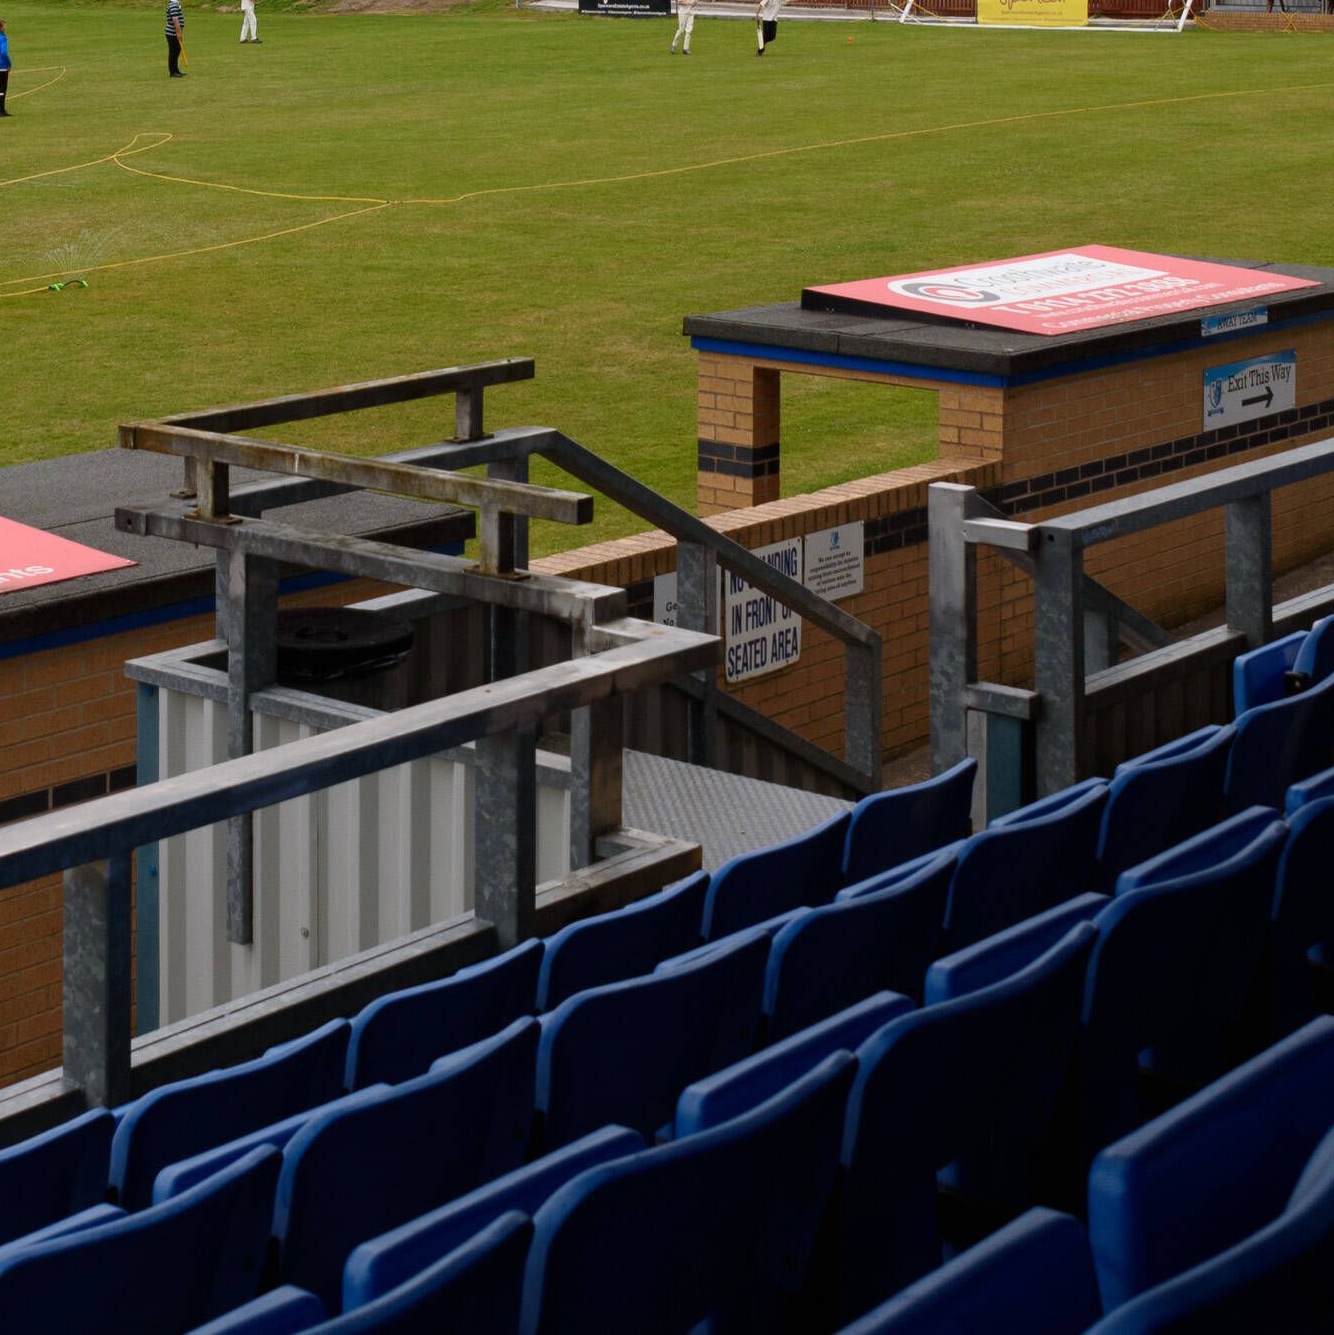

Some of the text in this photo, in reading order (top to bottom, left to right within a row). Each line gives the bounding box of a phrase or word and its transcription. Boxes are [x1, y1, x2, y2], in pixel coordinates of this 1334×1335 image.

[1217, 312, 1258, 330] AWAY TEAM
[1227, 363, 1292, 393] Exit This Way
[731, 602, 742, 636] IN
[727, 626, 799, 678] SEATED AREA
